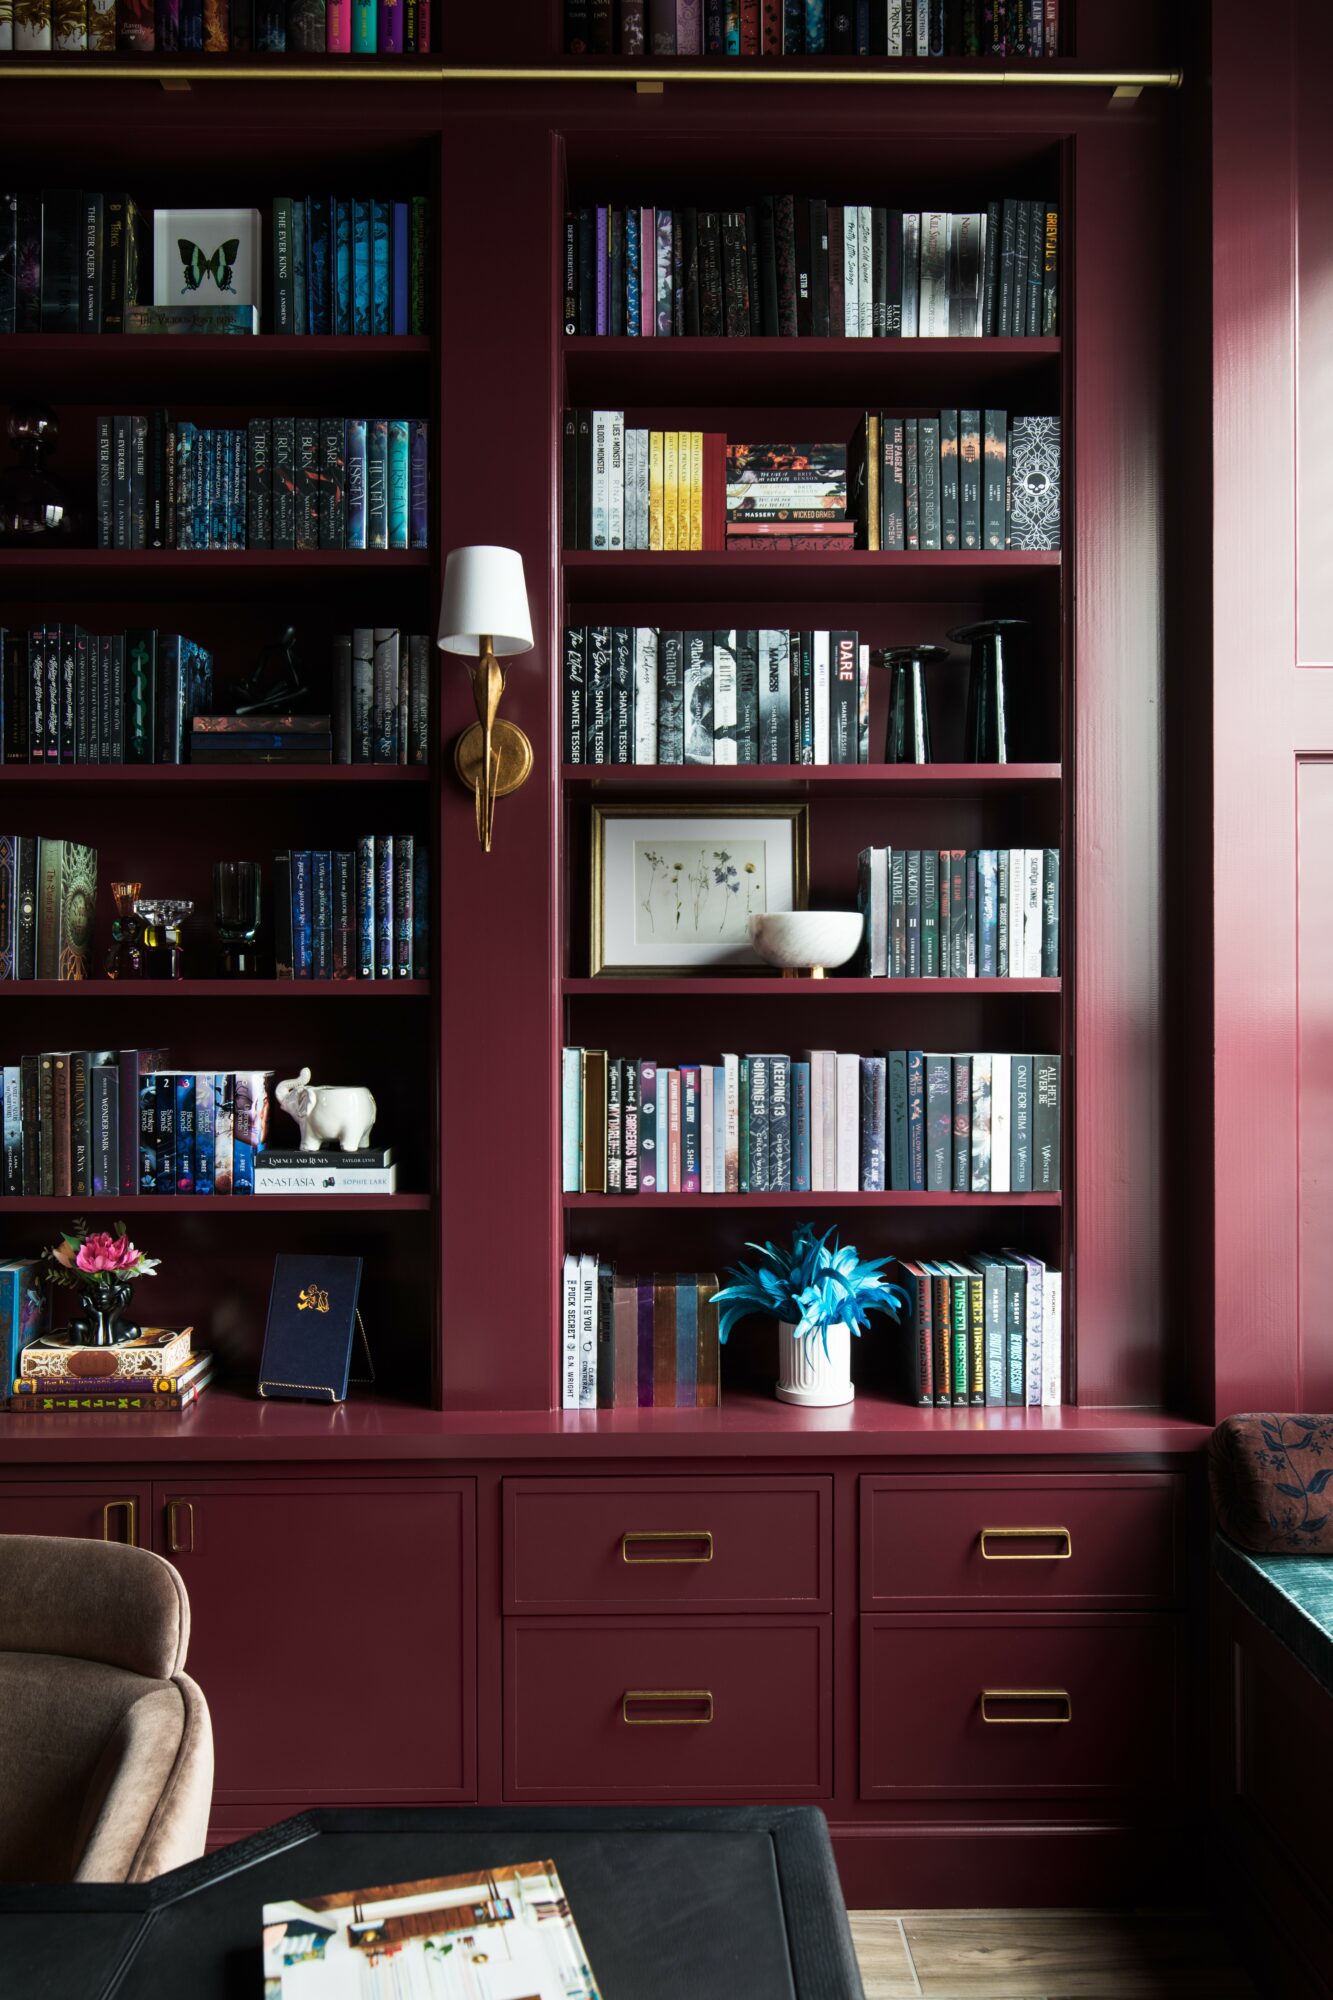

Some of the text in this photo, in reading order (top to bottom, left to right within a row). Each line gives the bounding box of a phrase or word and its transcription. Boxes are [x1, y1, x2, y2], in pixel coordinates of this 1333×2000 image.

[891, 6, 900, 39] PRINCE
[919, 8, 927, 41] NOTHING
[87, 206, 96, 279] THE EVER QUEEN
[111, 221, 122, 248] TRICK
[278, 211, 286, 279] THE EVER KING
[846, 222, 856, 286] Pretty Little Savage
[799, 273, 808, 299] SETTA JAY
[892, 304, 900, 331] LUCY
[100, 424, 109, 487] THE EVER KING
[255, 433, 265, 469] TRICK
[277, 436, 288, 464] RUIN
[301, 436, 313, 470] BURN
[327, 437, 337, 467] DARE
[612, 424, 620, 469] LIES MONSTER
[885, 443, 893, 466] DUET
[894, 427, 903, 484] THE PAGEANT
[925, 440, 934, 487] PROMISED
[925, 502, 934, 532] BLOOD
[567, 650, 584, 683] Ritual
[592, 651, 606, 686] Sinner
[616, 646, 628, 686] Sacrifice
[642, 646, 655, 684] Madness
[664, 640, 681, 687] Carnage
[690, 638, 704, 687] Madness
[741, 664, 753, 693] SINNER
[769, 648, 779, 693] MADNESS
[840, 640, 853, 681] DARE
[419, 721, 427, 749] STONE
[571, 690, 580, 764] SHANTEL TESSIER
[595, 690, 604, 764] SHANTEL TESSIER
[619, 690, 627, 763] SHANTEL TESSIER
[359, 861, 368, 915] SHADOW KING
[893, 856, 903, 906] INSATIABLE
[908, 856, 918, 906] VORACIOUS
[924, 856, 935, 910] RESTITUTION
[1030, 887, 1038, 909] SINNERS
[999, 903, 1007, 925] BECAUSE
[983, 944, 992, 959] Alina
[999, 934, 1007, 951] YOURS
[983, 960, 992, 972] May
[75, 1058, 85, 1116] GOTHIKANA
[163, 1078, 169, 1088] 2
[753, 1062, 765, 1115] BINDING 13
[774, 1062, 785, 1116] KEEPING 13
[1017, 1065, 1027, 1130] ONLY FOR HIM
[1038, 1069, 1048, 1105] EVER BE
[1047, 1066, 1056, 1108] ALL HE'LL
[101, 1096, 109, 1152] WONDER DARK
[146, 1108, 154, 1133] Broken
[269, 1157, 329, 1166] ESSENCE AND RUNES
[609, 1104, 621, 1188] MY DARLING ARROW
[625, 1104, 637, 1189] A GORGEOUS VILLAIN
[259, 1177, 315, 1187] ANASTASIA
[567, 1286, 576, 1340] PUCK SECRET
[584, 1280, 592, 1303] UNTIL
[584, 1315, 592, 1332] YOU
[918, 1279, 931, 1394] BRUTAL OBSESSION
[937, 1279, 949, 1394] SECRET OBSESSION
[954, 1280, 966, 1394] TWISTED OBSESSION
[971, 1280, 983, 1393] FIERCE OBSESSION
[989, 1332, 1002, 1398] BRUTAL OBSESSION
[1010, 1333, 1023, 1395] DEVIOUS OBSESSION
